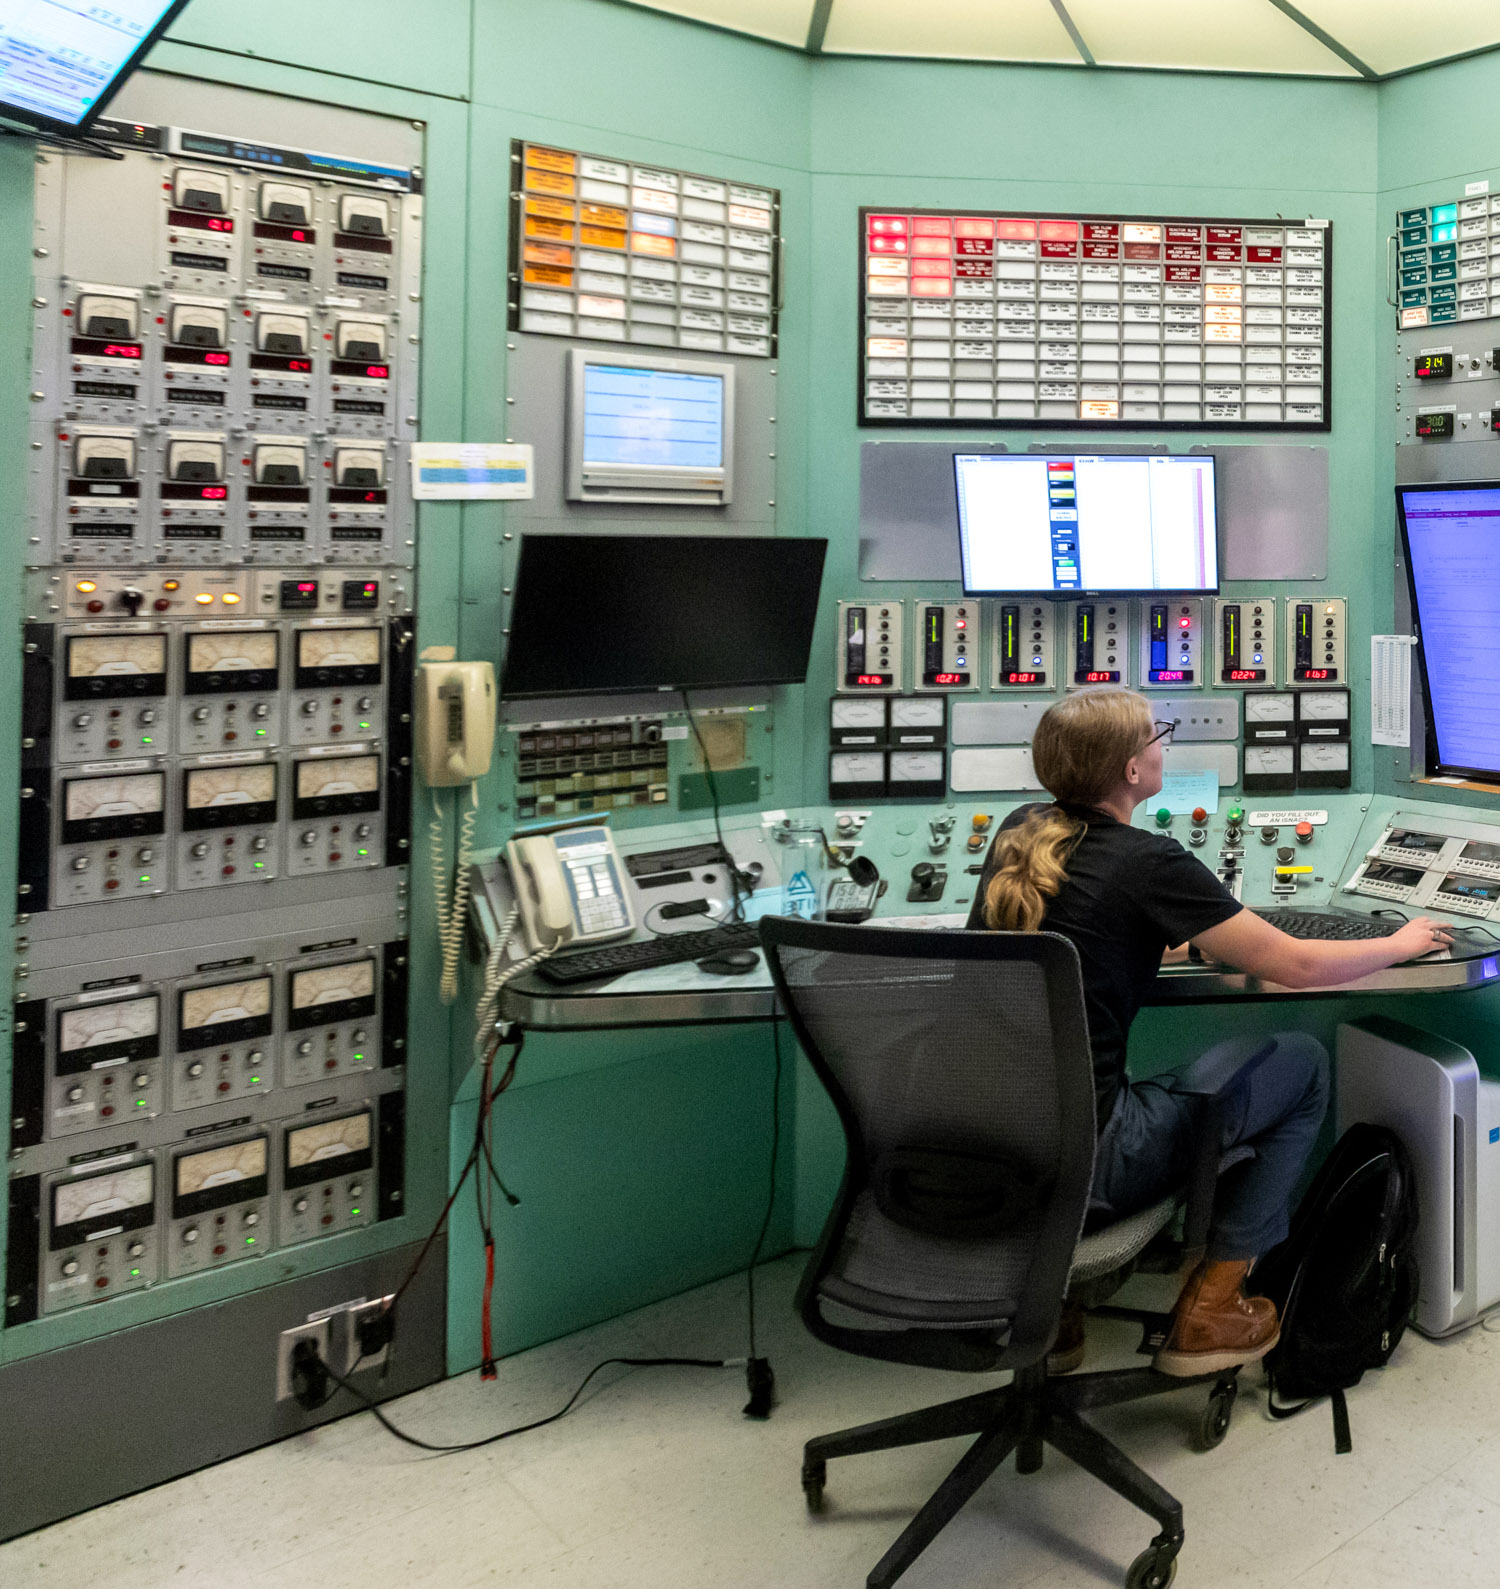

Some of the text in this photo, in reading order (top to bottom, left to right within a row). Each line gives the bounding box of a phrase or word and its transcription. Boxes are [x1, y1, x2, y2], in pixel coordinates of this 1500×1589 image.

[1425, 357, 1443, 369] 31.4
[1008, 673, 1035, 682] 01.01
[1086, 671, 1110, 681] 10.17
[1158, 671, 1183, 681] 20.49
[1231, 670, 1256, 680] 02.24
